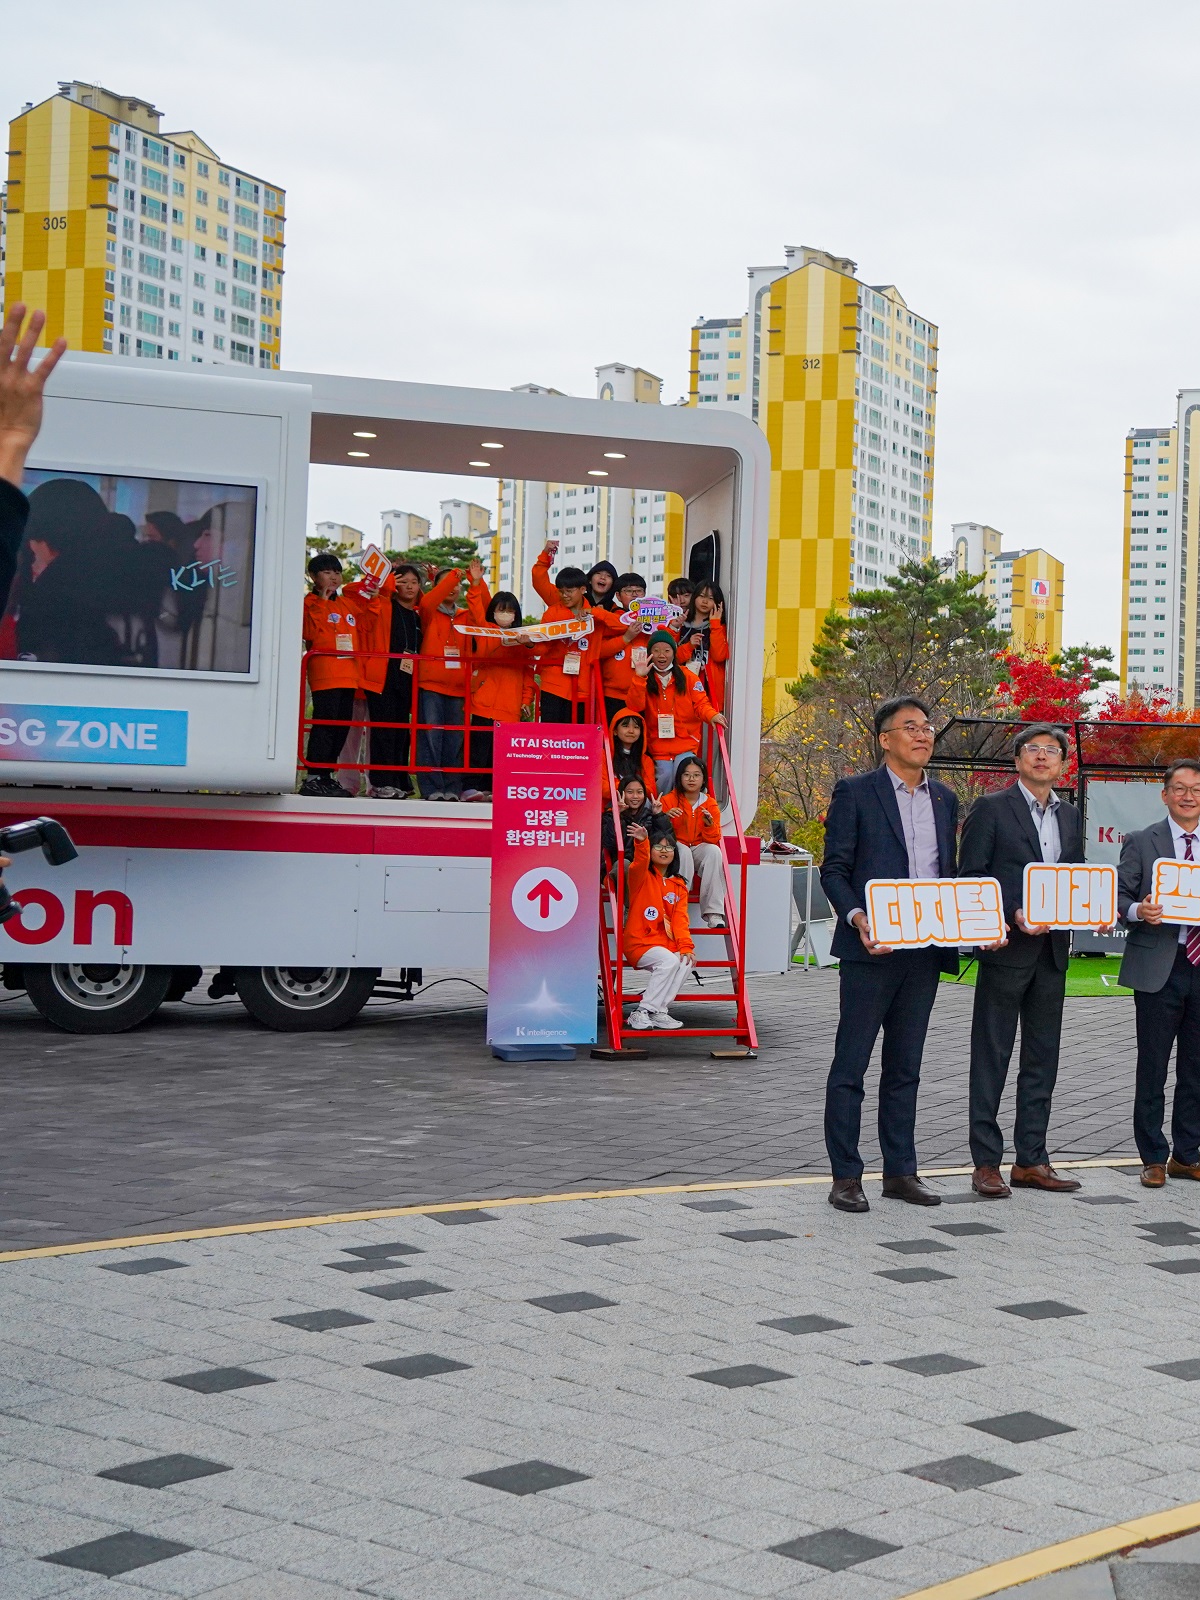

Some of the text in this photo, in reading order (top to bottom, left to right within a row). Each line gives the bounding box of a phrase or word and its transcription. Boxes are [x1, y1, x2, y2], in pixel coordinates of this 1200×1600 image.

[43, 216, 67, 230] 305
[802, 358, 820, 370] 312
[364, 551, 386, 577] AI
[640, 607, 662, 616] 디지털
[1034, 612, 1045, 620] 318
[56, 720, 158, 750] ZONE
[511, 738, 585, 749] KT AI Station
[507, 786, 587, 801] ESG ZONE
[524, 810, 569, 827] 입장을
[506, 829, 585, 847] 환영합니다!
[1098, 827, 1114, 843] K
[1028, 867, 1115, 926] 미래
[647, 908, 656, 917] kt
[871, 883, 1002, 945] 디지털
[516, 1026, 568, 1038] K intelligence
